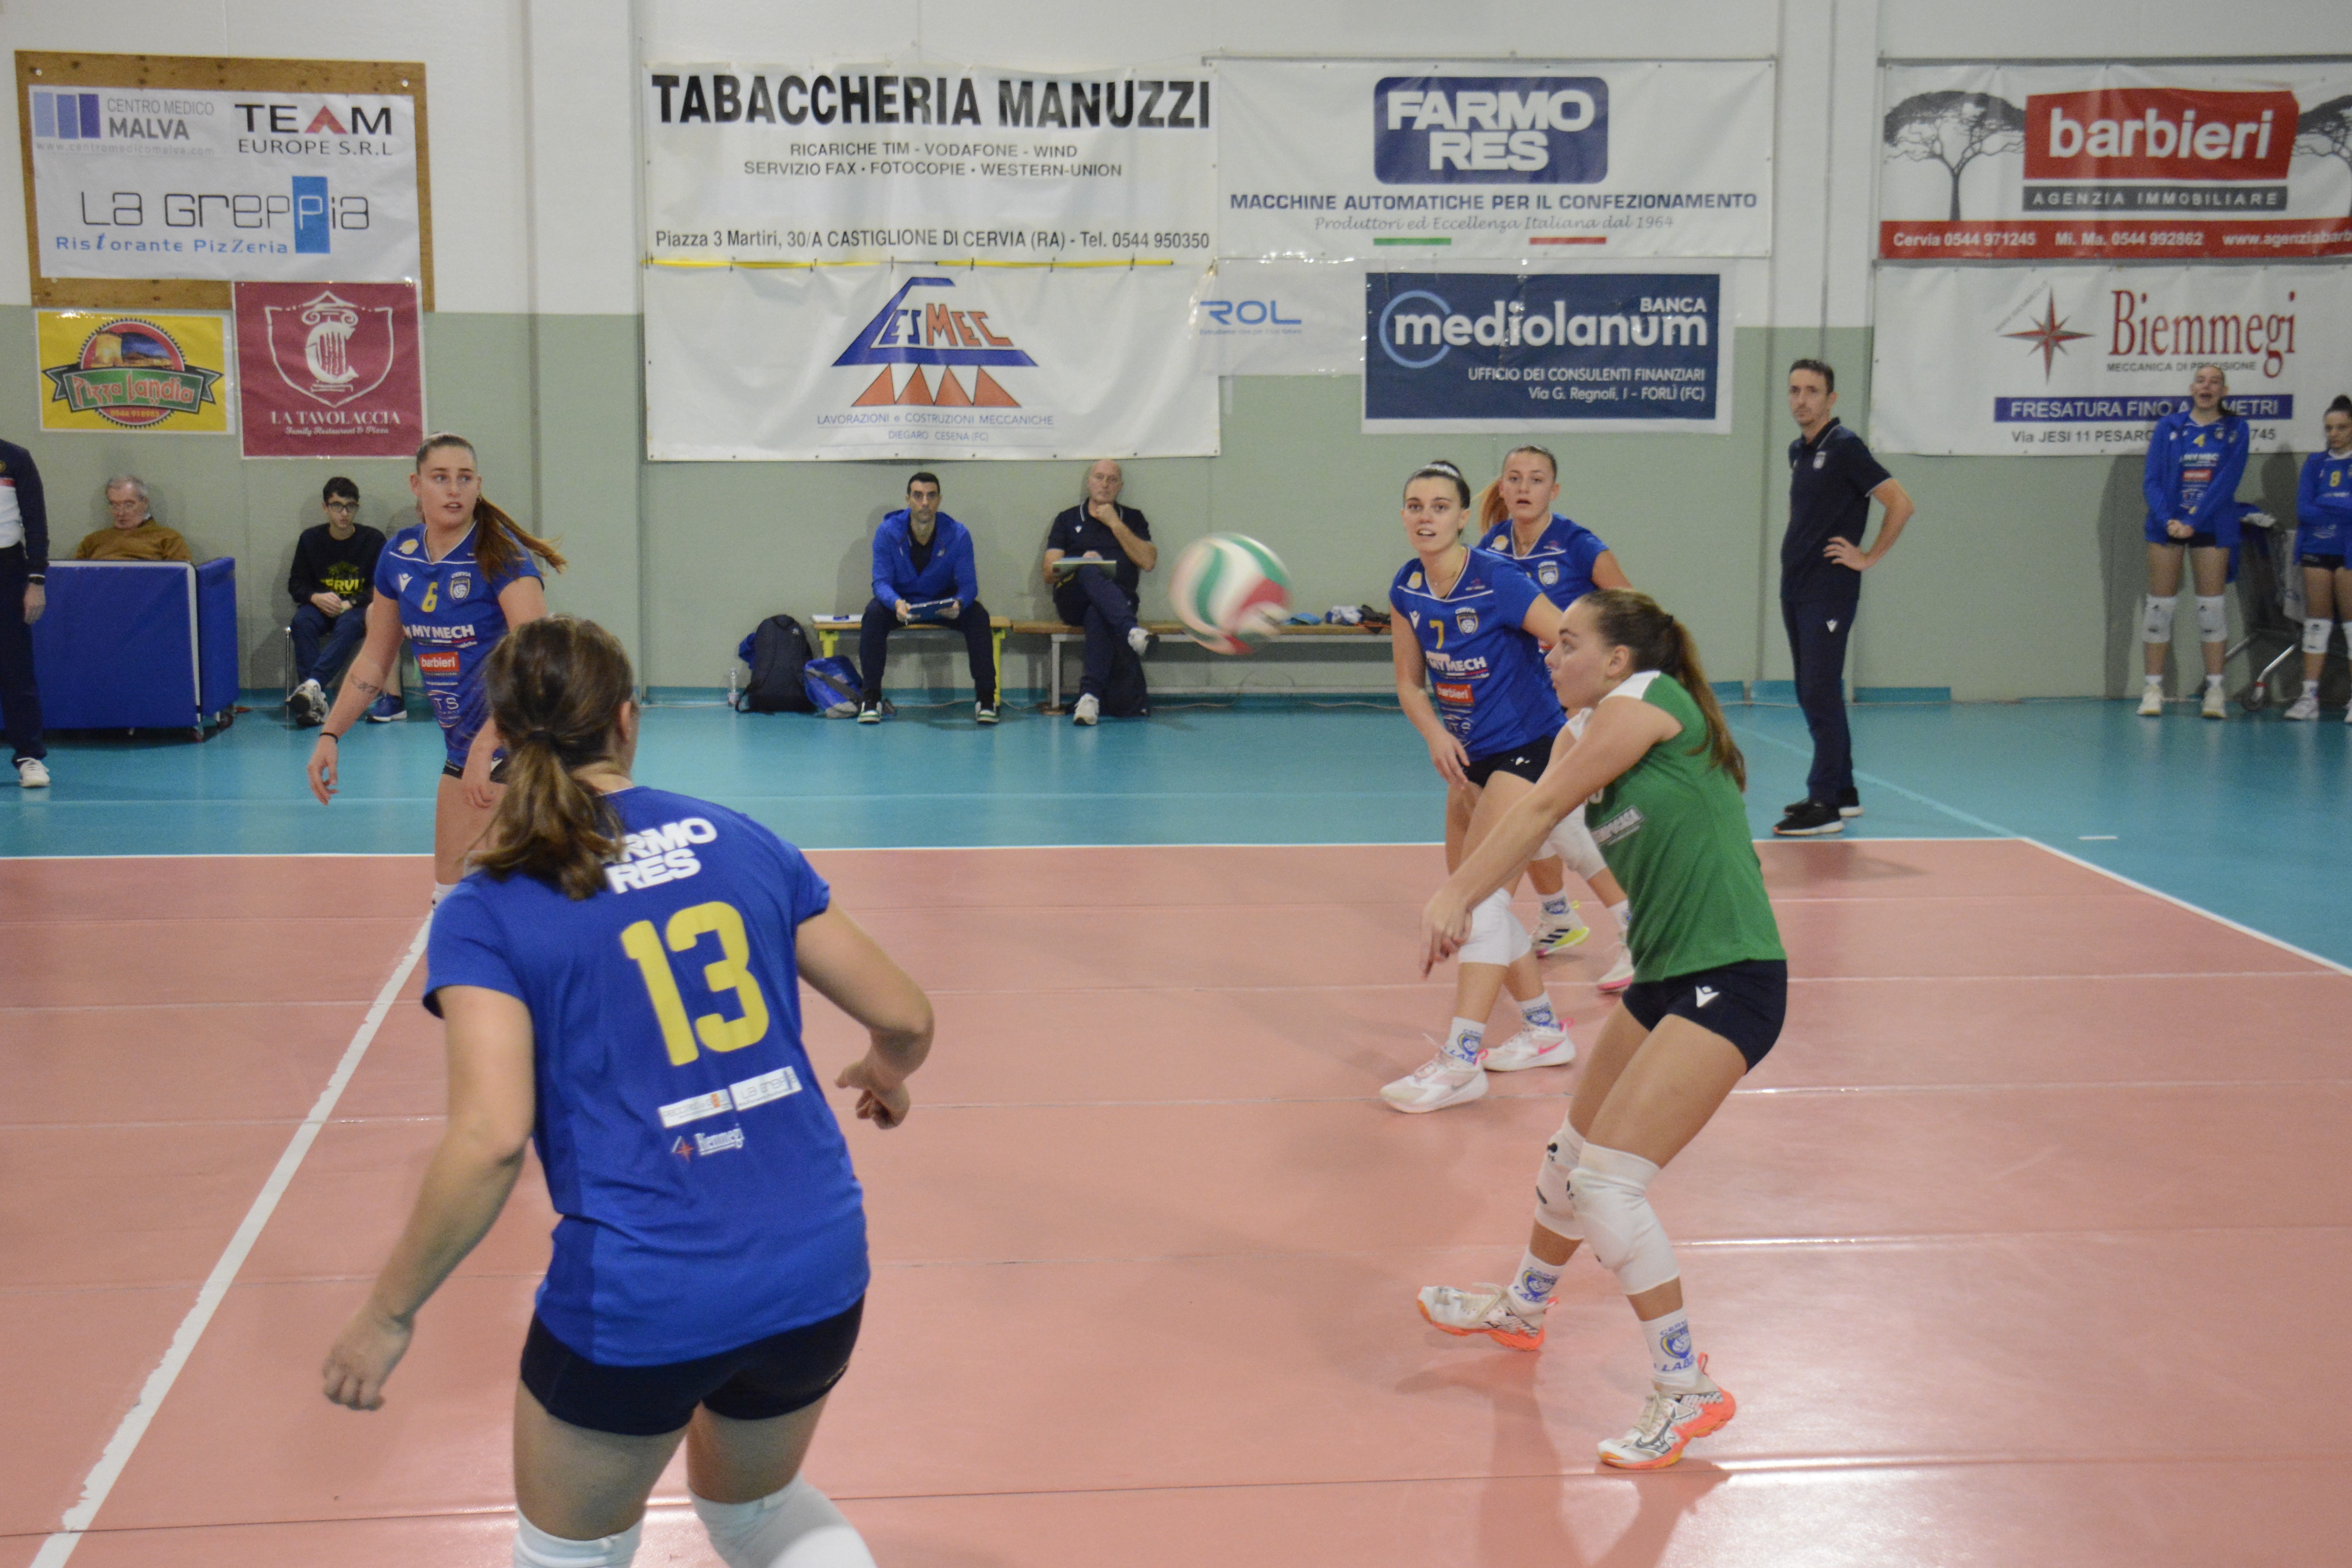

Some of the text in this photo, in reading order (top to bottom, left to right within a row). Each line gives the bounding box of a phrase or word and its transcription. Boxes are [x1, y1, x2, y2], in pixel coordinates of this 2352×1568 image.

[107, 98, 214, 116] CENTRO MEDICO
[652, 75, 1209, 129] TABACCHERIA MANUZZI
[1387, 89, 1595, 132] FARMO
[109, 117, 190, 140] MALVA
[234, 103, 392, 135] TEAM
[2049, 107, 2274, 160] barbieri
[36, 141, 214, 156] www.centromedicomalva.com
[238, 139, 392, 156] EUROPE S.R.L
[790, 143, 876, 156] RICARICHE
[882, 143, 910, 155] TIM
[925, 143, 1018, 157] VODAFONE
[1034, 145, 1078, 158] WIND
[1429, 131, 1549, 172] RES
[744, 161, 1122, 177] SERVIZIO FAX FOTOCOPIE WESTERN-UNION
[1230, 193, 1758, 210] MACCHINE AUTOMATICHE PER IL CONFEZIONAMENTO
[2032, 191, 2278, 205] AGENZIA IMMOBILIARE
[1315, 215, 1674, 234] Produttori ed Eccellenza Italiana dal 1964
[56, 233, 184, 253] Ristorante
[656, 231, 709, 247] Piazza
[713, 231, 722, 246] 3
[728, 230, 783, 250] Martiri,
[787, 231, 822, 247] 30/A
[828, 229, 938, 246] CASTIGLIONE
[943, 229, 959, 246] DI
[963, 230, 1026, 247] CERVIA
[1031, 231, 1066, 251] (RA)
[1080, 231, 1107, 248] Tel.
[1112, 232, 1149, 249] 0544
[1154, 233, 1209, 249] 950350
[1893, 232, 1941, 246] Cervia
[1944, 232, 1980, 246] 0544
[1984, 231, 2037, 246] 971245
[2054, 232, 2077, 246] Mi.
[2081, 232, 2107, 246] Ma.
[2111, 231, 2146, 246] 0544
[1200, 300, 1303, 325] ROL
[1640, 297, 1708, 313] BANCA
[1393, 300, 1708, 347] mediolanum
[2108, 289, 2297, 379] Biemmegi
[1467, 367, 1706, 381] UFFICIO DEI CONSULENTI FINANZIARI
[2106, 361, 2173, 372] MECCANICA
[2175, 362, 2188, 371] DI
[72, 374, 123, 408] Pizza
[1528, 387, 1549, 400] Via
[1552, 387, 1566, 400] G.
[1570, 386, 1619, 403] Regnoli,
[1641, 384, 1678, 401] FORLÌ
[1680, 386, 1706, 402] (FC)
[271, 411, 401, 425] LA TAVOLACCIA
[2010, 401, 2125, 418] FRESATURA
[2127, 401, 2173, 417] FINO
[2177, 400, 2189, 413] A
[817, 414, 890, 425] LAVORAZIONI
[904, 413, 975, 425] COSTRUZIONI
[979, 414, 1054, 425] MECCANICHE
[285, 426, 312, 437] Family
[365, 426, 389, 434] Pizza
[888, 430, 989, 442] DIEGARO CESENA (FC)
[2012, 431, 2034, 443] Via
[2039, 429, 2071, 443] JESI
[2075, 430, 2090, 442] 11
[421, 582, 438, 613] 6
[1429, 620, 1444, 650] 7
[421, 657, 455, 668] barbieri
[613, 817, 718, 863] RMO
[604, 848, 702, 894] RES
[620, 900, 770, 1067] 13
